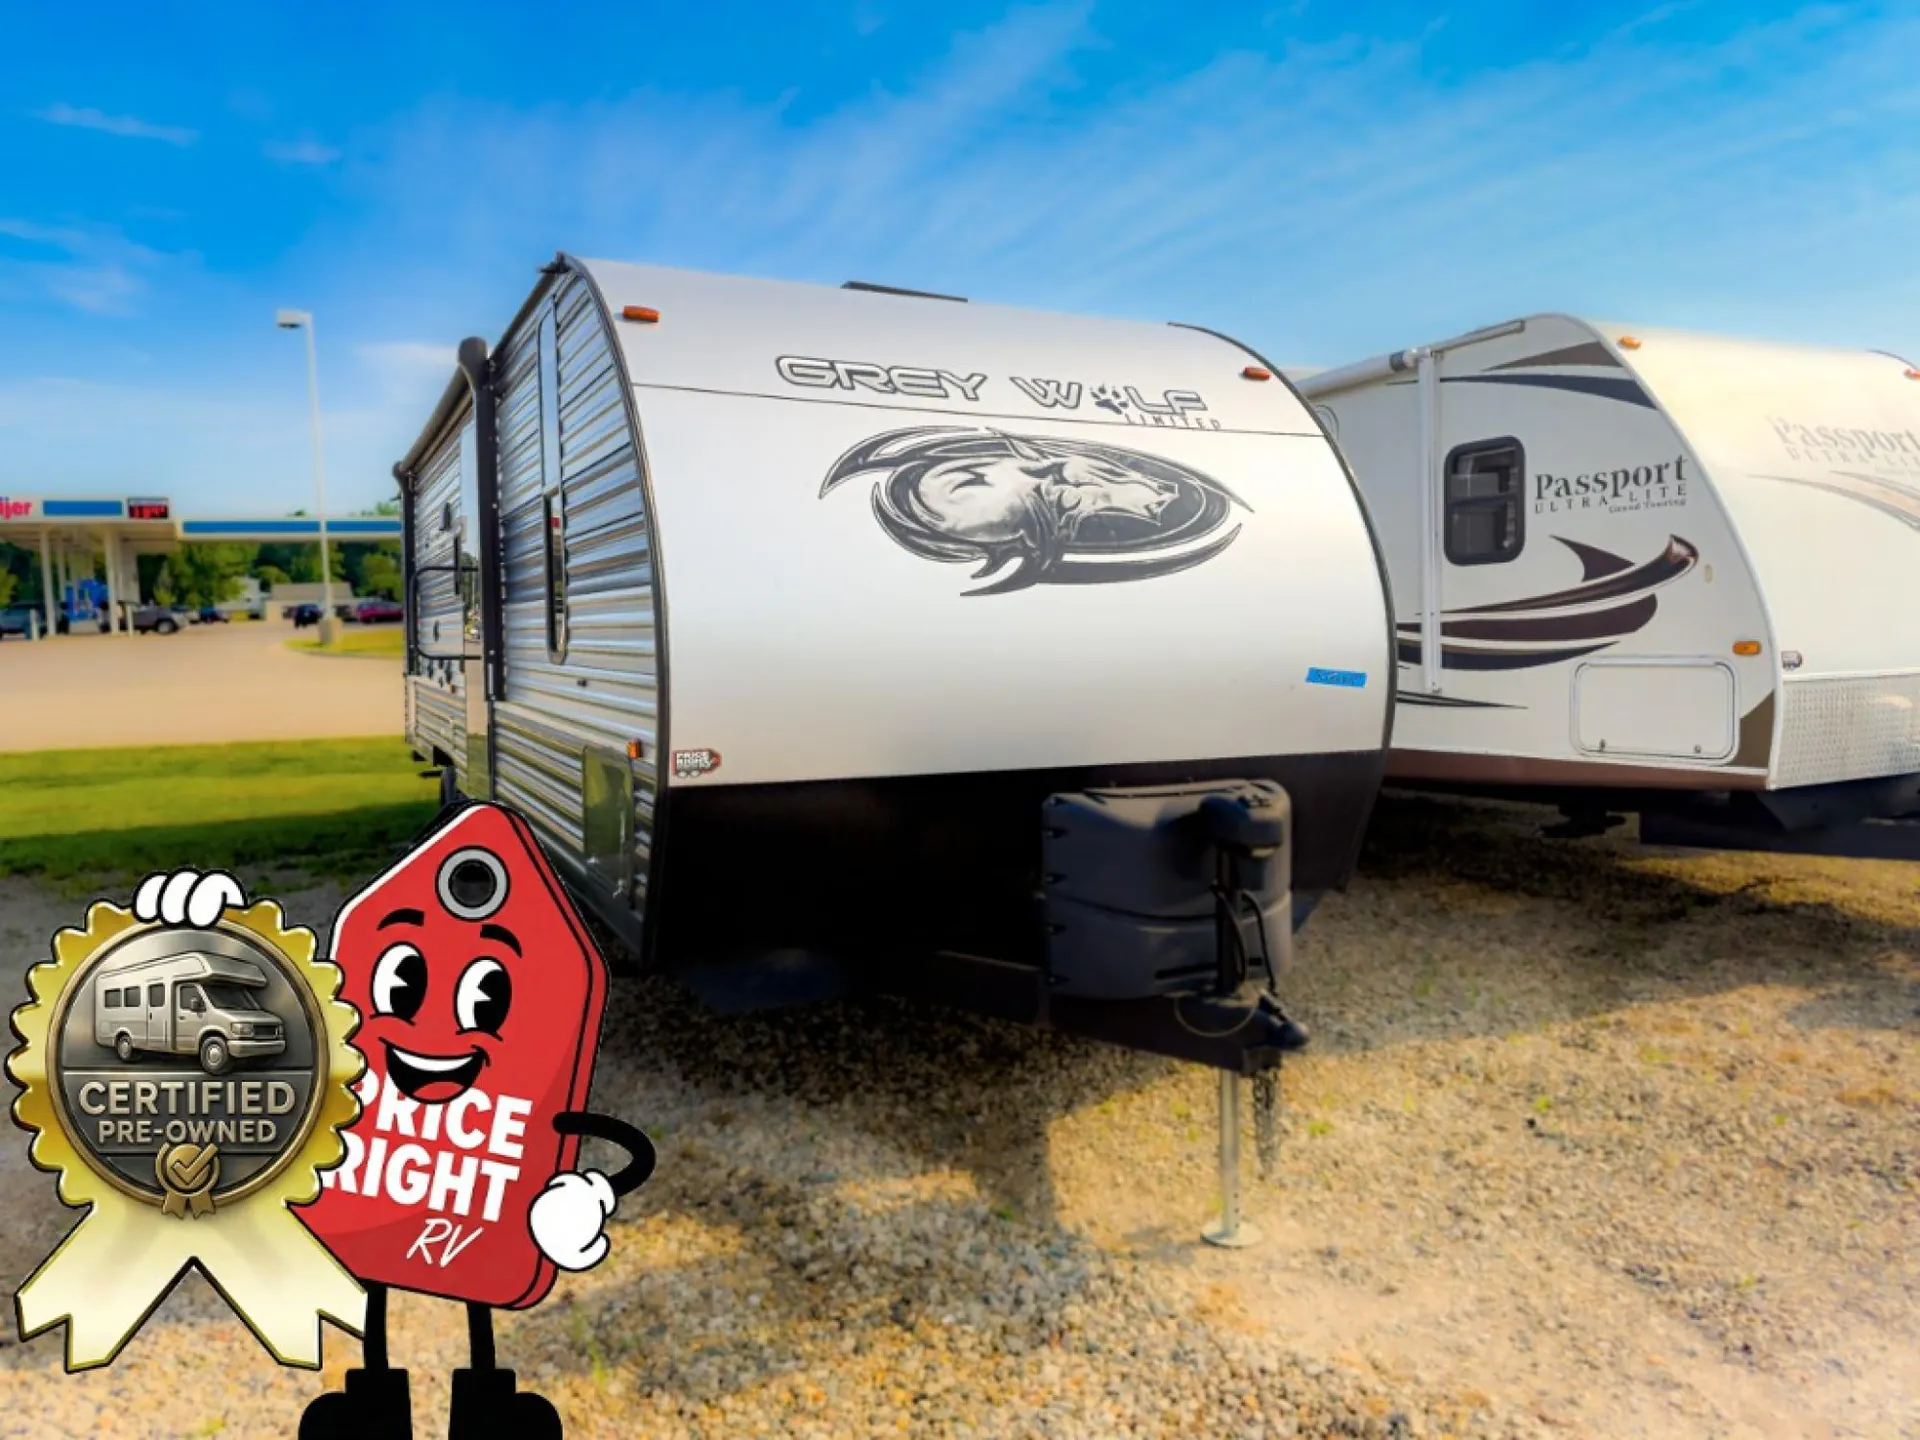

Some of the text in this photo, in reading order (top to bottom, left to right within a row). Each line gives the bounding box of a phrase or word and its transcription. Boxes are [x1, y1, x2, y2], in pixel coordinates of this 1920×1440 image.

[775, 356, 988, 401] GREY
[1124, 413, 1222, 431] LIMITED
[1534, 454, 1689, 500] Passport
[1535, 483, 1688, 515] ULTRA LITE
